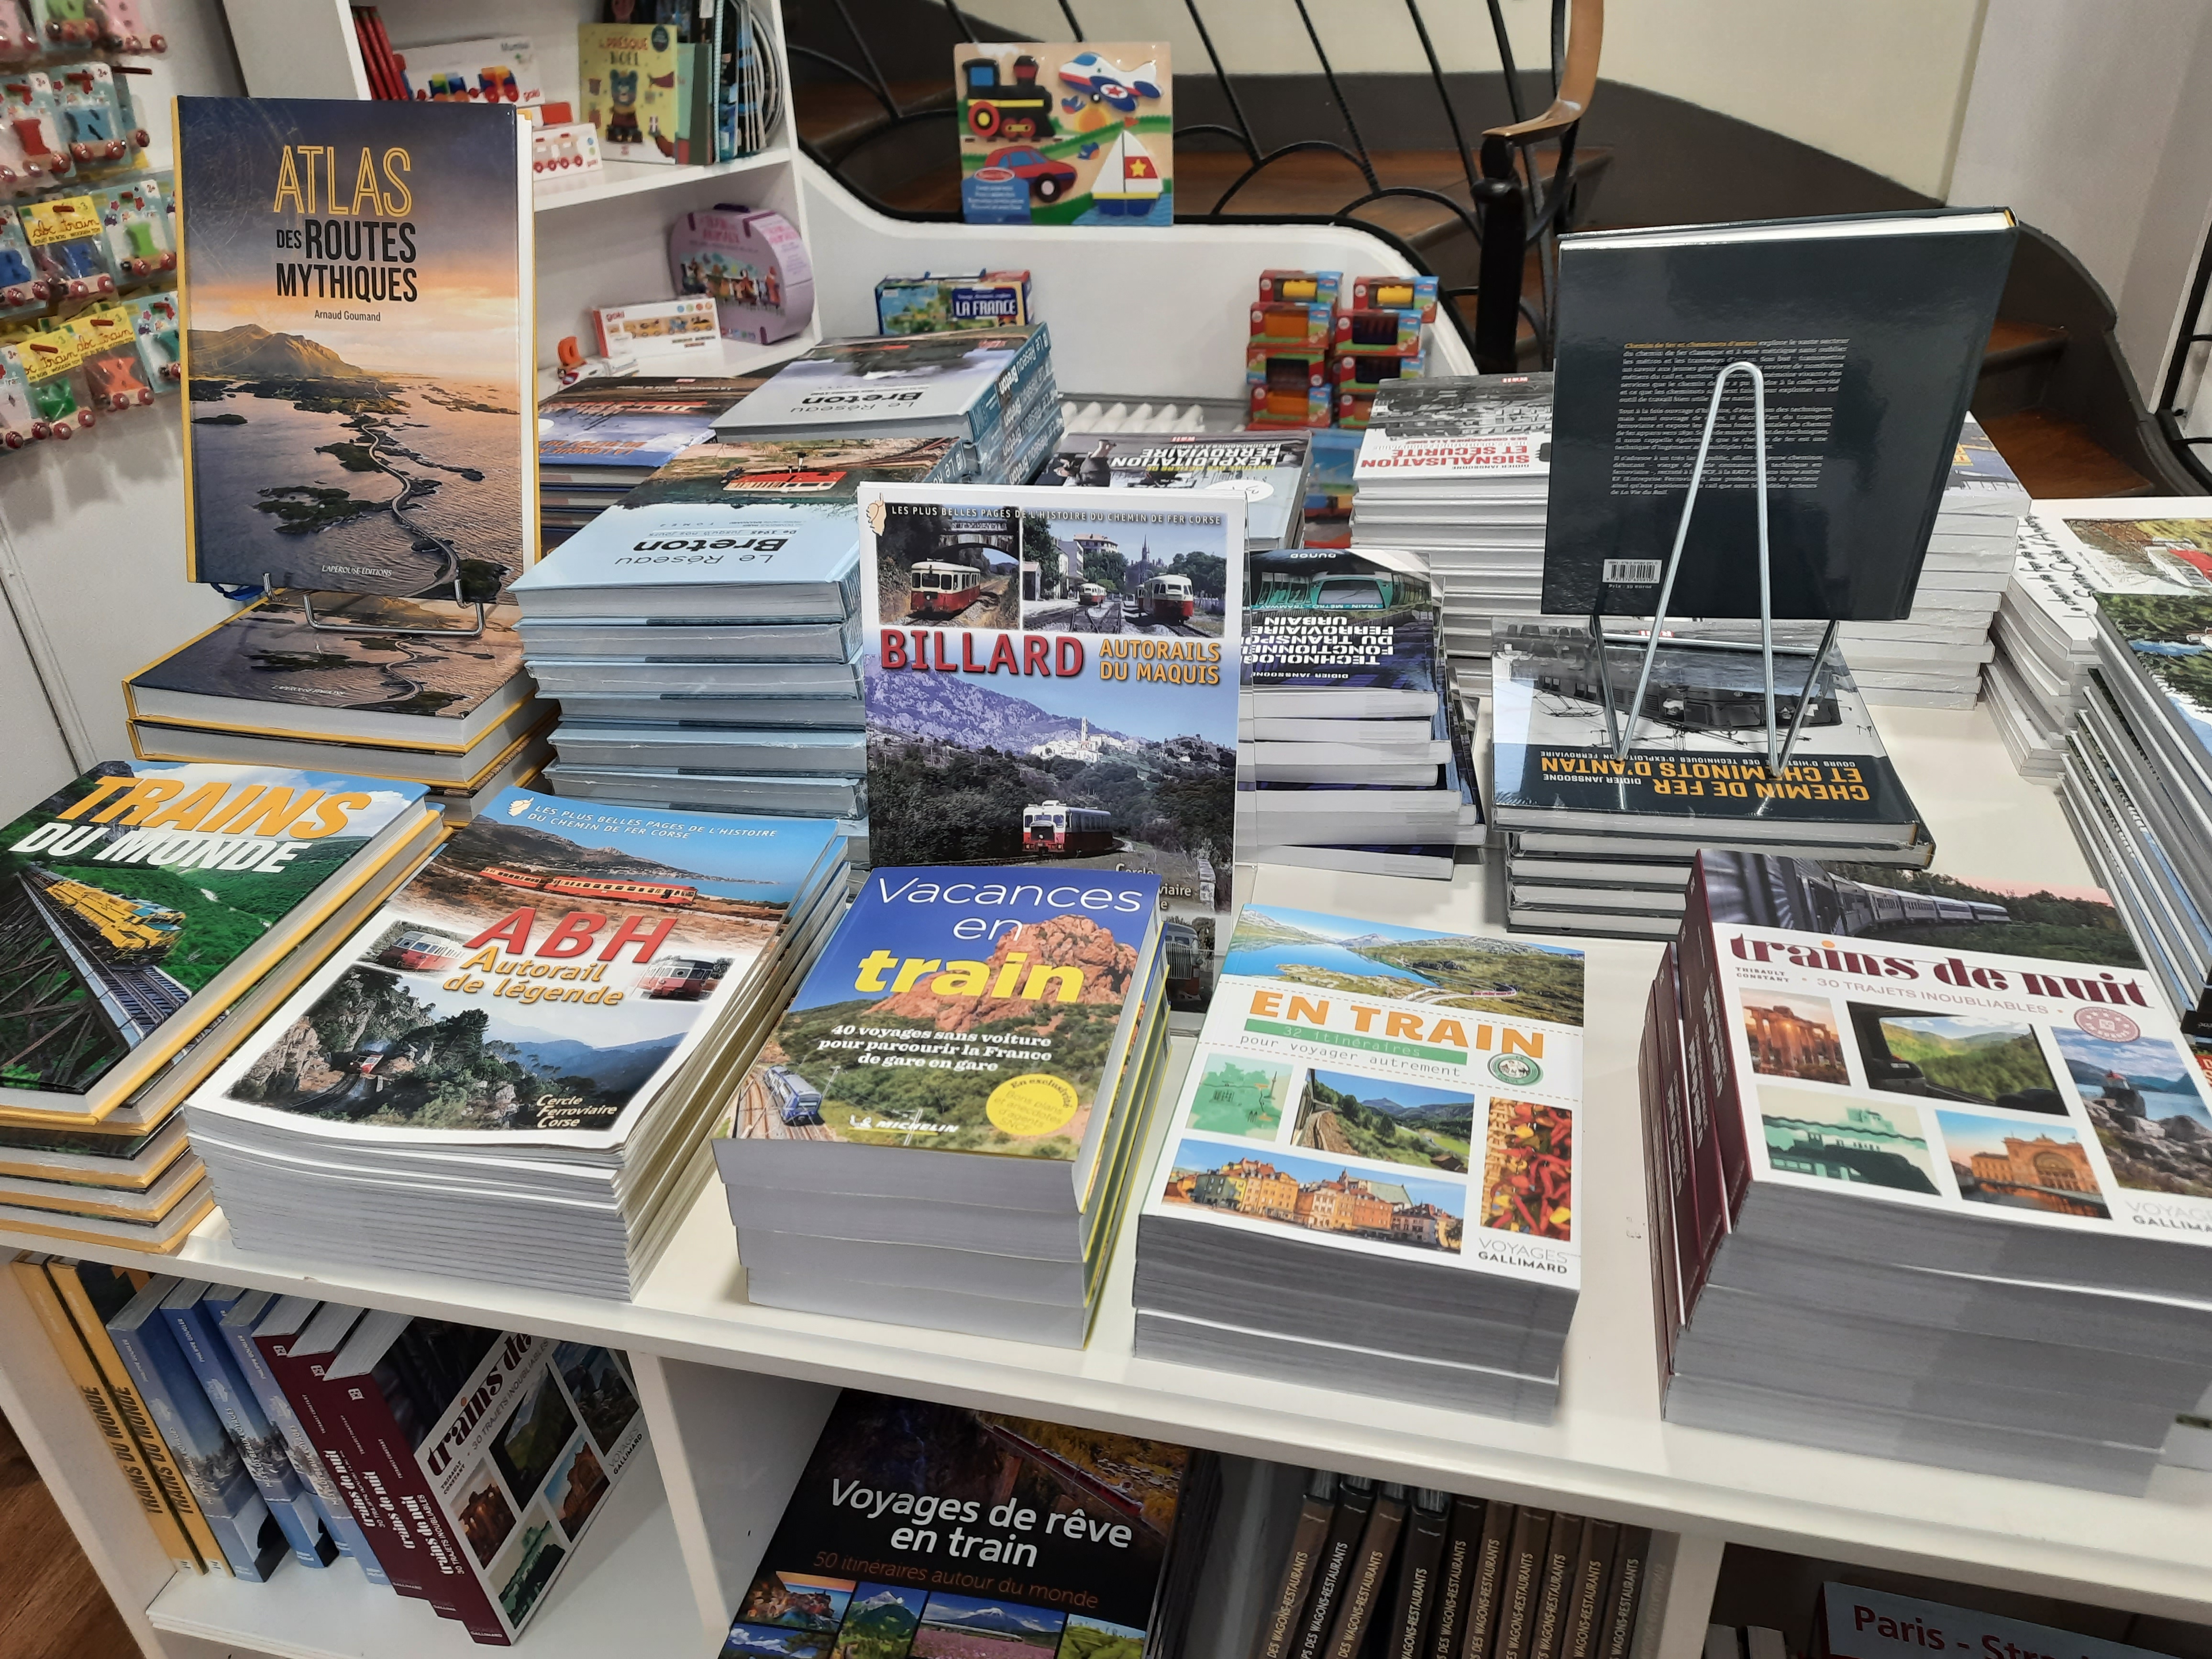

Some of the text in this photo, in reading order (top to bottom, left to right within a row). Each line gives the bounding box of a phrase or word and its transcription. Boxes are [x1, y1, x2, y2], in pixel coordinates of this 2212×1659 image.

[273, 145, 412, 217] ATLAS
[61, 219, 100, 229] train
[276, 219, 416, 263] DES ROUTES
[276, 263, 417, 302] MYTHIQUES
[315, 310, 380, 321] Arnaud Goumand
[957, 299, 1017, 316] LA FRANCE
[998, 368, 1018, 394] Breton
[802, 392, 924, 405] Breton
[1111, 457, 1277, 466] L'EXPLOITATION
[1140, 448, 1280, 458] FERROVIAIRE
[1360, 455, 1529, 468] SIGNALISATION
[1502, 445, 1527, 454] ET
[1009, 459, 1030, 484] Breton
[892, 506, 1221, 525] LES PLUS BELLES PAGES DE L'HISTOIRE DU CHEMIN DE FER CORSE
[614, 553, 773, 565] Le Réseau
[633, 539, 788, 552] Breton
[1251, 626, 1394, 635] FERROVIAIRE
[1264, 617, 1347, 625] URBAIN
[880, 630, 1221, 678] BILLARD AUTORAILS
[1362, 636, 1392, 644] DU
[1100, 660, 1220, 685] DU MAQUIS
[1542, 757, 1862, 783] ET D'ANTAN
[1543, 774, 1641, 785] DIDIER JANSSOONE
[1653, 778, 1869, 801] CHEMIN DE FER
[56, 776, 372, 840] TRAINS
[535, 805, 777, 838] LES PLUS BELLES PAGES DE L'HISTOIRE
[527, 813, 691, 840] DU CHEMIN DE FER CORSE
[8, 822, 312, 874] DU MONDE
[878, 877, 1143, 913] Vacances
[463, 907, 678, 964] ABH
[953, 917, 1023, 942] en
[460, 946, 608, 983] Autorail
[854, 950, 1084, 1004] train
[1730, 933, 2155, 1009] trains de nuit
[1735, 966, 1790, 983] THIBAULT CONSTANT
[442, 973, 624, 1005] de légende
[1817, 977, 2049, 1014] 30 TRAJETS INOUBLIABLES
[831, 1025, 1051, 1047] 40 voyages sans voiture
[1250, 990, 1544, 1059] EN TRAIN
[817, 1039, 1052, 1061] pour parcourir la France
[1240, 1035, 1460, 1077] pour voyager autrement
[1283, 1026, 1421, 1057] 32 itinéraires
[858, 1053, 998, 1072] de gare en gare
[536, 1094, 583, 1106] Cercle
[1010, 1080, 1027, 1089] En
[536, 1105, 618, 1118] Ferroviaire
[537, 1116, 580, 1129] Corse
[875, 1120, 959, 1134] MICHELIN
[1478, 1250, 1568, 1274] GALLIMARD
[1479, 1237, 1568, 1264] VOYAGES
[472, 1339, 550, 1450] 30 TRAJETS INOUBLIABLES
[111, 1385, 154, 1439] MONDE
[427, 1365, 503, 1476] trains
[81, 1385, 164, 1514] TRAINS DU MONDE
[142, 1442, 166, 1462] DU
[323, 1450, 348, 1474] nuit
[609, 1427, 639, 1468] VOYAGES
[613, 1433, 643, 1475] GALLIMARD
[154, 1465, 194, 1514] TRAINS
[362, 1471, 385, 1496] nuit
[441, 1459, 463, 1489] THIBAULT
[443, 1463, 465, 1495] CONSTANT
[350, 1492, 376, 1527] trains
[830, 1478, 1133, 1549] Voyages de rêve
[387, 1513, 416, 1549] trains
[399, 1495, 454, 1575] trains nuit
[417, 1494, 465, 1575] 30 TRAJETS INOUBLIABLES
[890, 1526, 1037, 1568] en train
[813, 1550, 1099, 1609] 50 itinéraires autour du monde
[1305, 1541, 1348, 1649] DES WAGONS-RESTAURANTS
[1471, 1538, 1500, 1652] DES WAGONS-RESTAURANTS
[1266, 1550, 1308, 1659] DES WAGONS-RESTAURANTS
[1338, 1550, 1383, 1659] DES WAGONS-RESTAURANTS
[1437, 1540, 1466, 1654] DES WAGONS-RESTAURANTS
[1507, 1552, 1534, 1649] WAGONS-RESTAURANTS
[1539, 1554, 1566, 1651] WAGONS-RESTAURANTS
[1574, 1560, 1601, 1659] WAGONS-RESTAURANTS
[1611, 1558, 1639, 1656] WAGONS-RESTAURANTS
[1854, 1604, 1946, 1651] Paris
